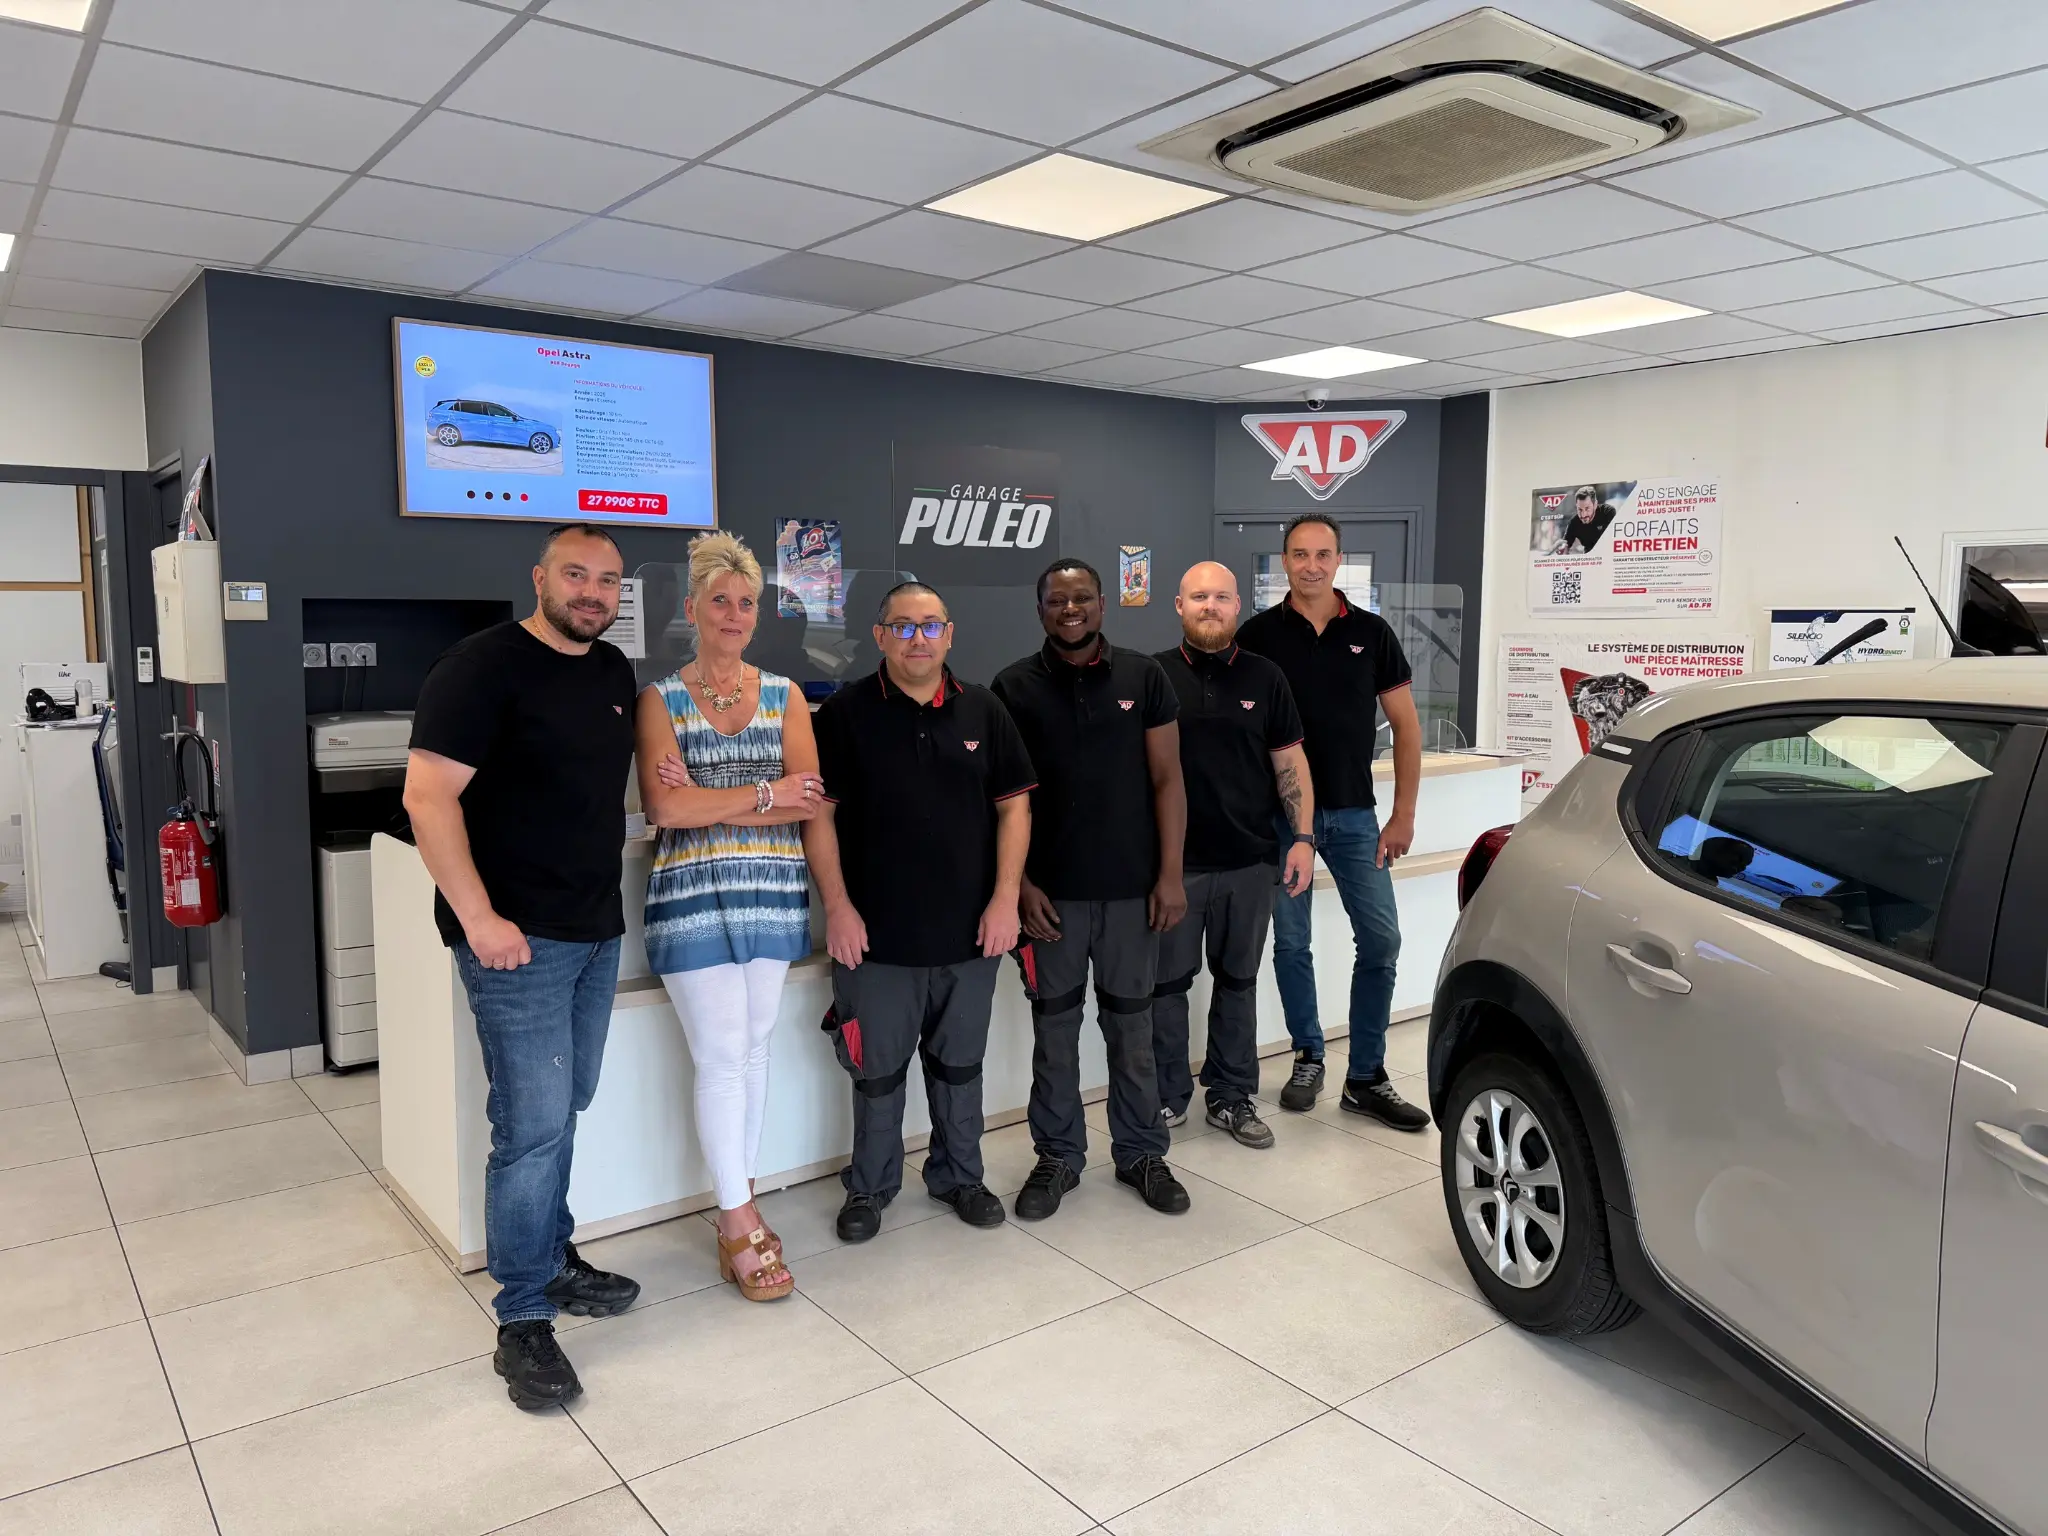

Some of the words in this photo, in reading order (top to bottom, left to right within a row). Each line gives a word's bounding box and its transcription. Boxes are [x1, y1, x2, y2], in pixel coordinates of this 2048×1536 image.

[537, 347, 560, 357] Opel
[562, 350, 591, 360] Astra
[1277, 424, 1369, 475] AD
[950, 484, 1022, 501] GARAGE
[1637, 488, 1654, 500] AD
[1657, 484, 1717, 499] S'ENGAGE
[587, 494, 602, 506] 27
[604, 496, 636, 508] 990€
[638, 498, 660, 509] TTC
[1544, 496, 1561, 508] AD
[1643, 498, 1681, 507] MAINTENIR
[1699, 496, 1717, 504] PRIX
[1668, 506, 1690, 514] JUSTE
[898, 497, 1052, 549] PULEO
[1613, 518, 1699, 538] FORFAITS
[1613, 536, 1698, 552] ENTRETIEN
[1588, 644, 1600, 652] LE
[1601, 642, 1648, 653] SYSTÈME
[1650, 644, 1664, 653] DE
[1666, 644, 1744, 654] DISTRIBUTION
[1624, 656, 1646, 664] UNE
[1648, 654, 1678, 664] PIÈCE
[1680, 654, 1744, 666] MAÎTRESSE
[1644, 667, 1658, 676] DE
[1660, 668, 1694, 676] VOTRE
